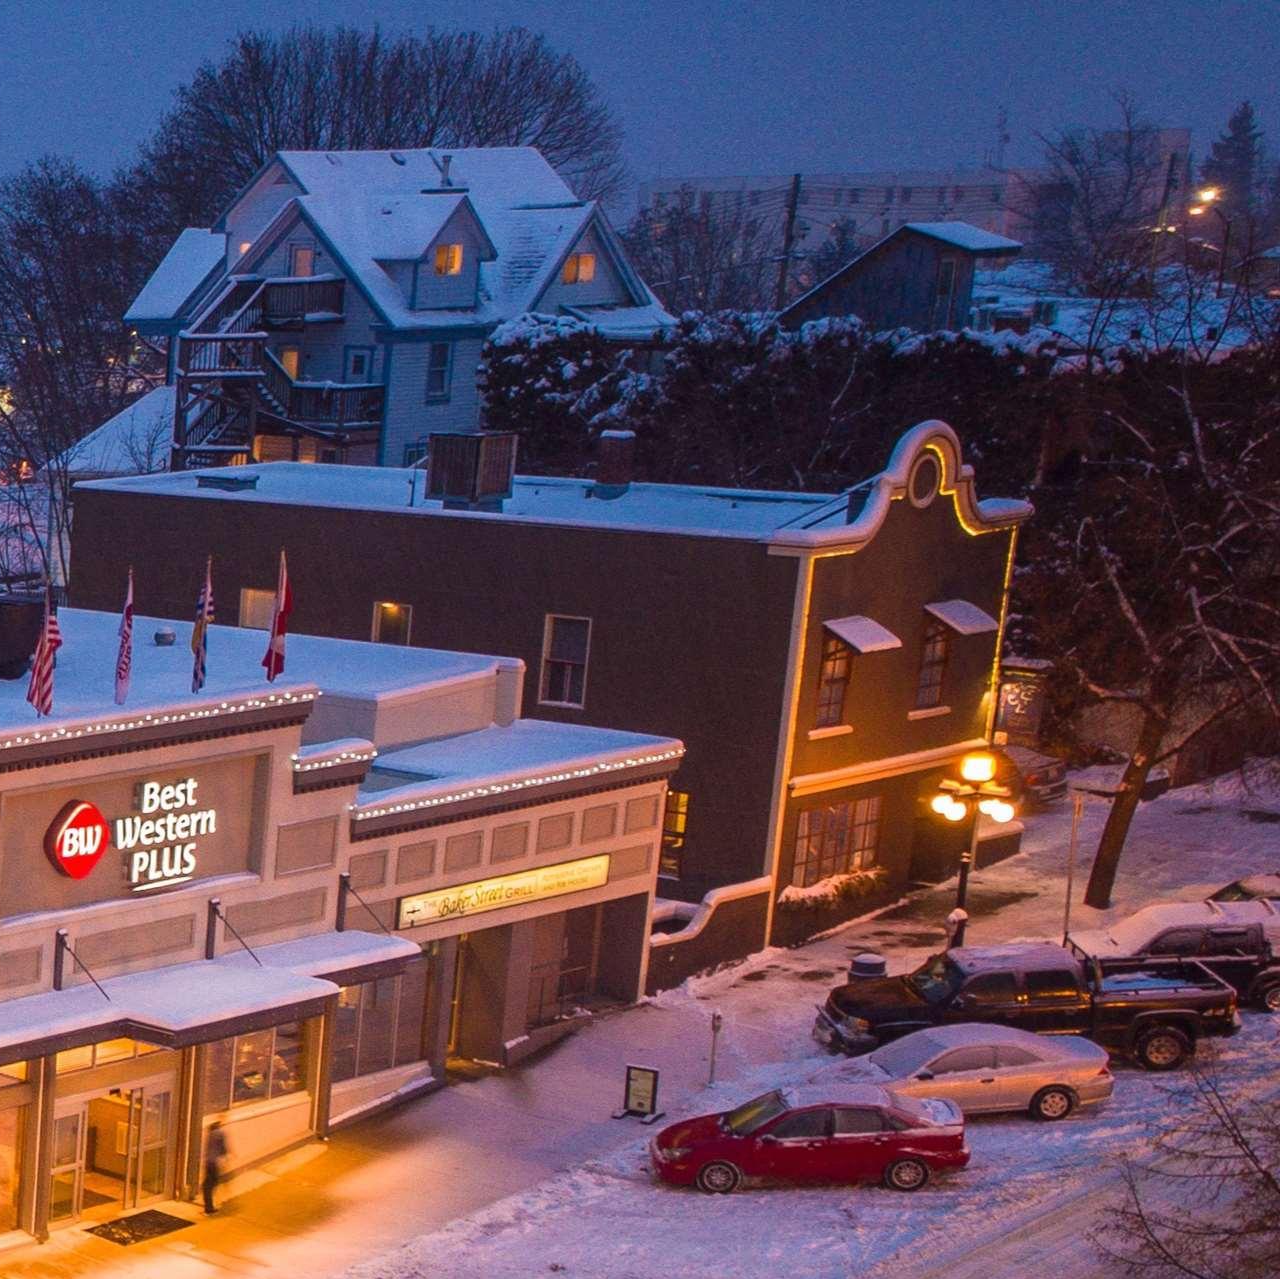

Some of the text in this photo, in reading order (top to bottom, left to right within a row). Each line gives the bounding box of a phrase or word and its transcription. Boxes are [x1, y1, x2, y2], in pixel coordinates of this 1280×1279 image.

[142, 778, 198, 814] Best
[62, 825, 102, 858] BW
[116, 809, 216, 850] Western
[131, 843, 197, 883] PLUS
[438, 889, 471, 917] Baker
[471, 884, 504, 907] Street
[505, 884, 534, 898] GRILL
